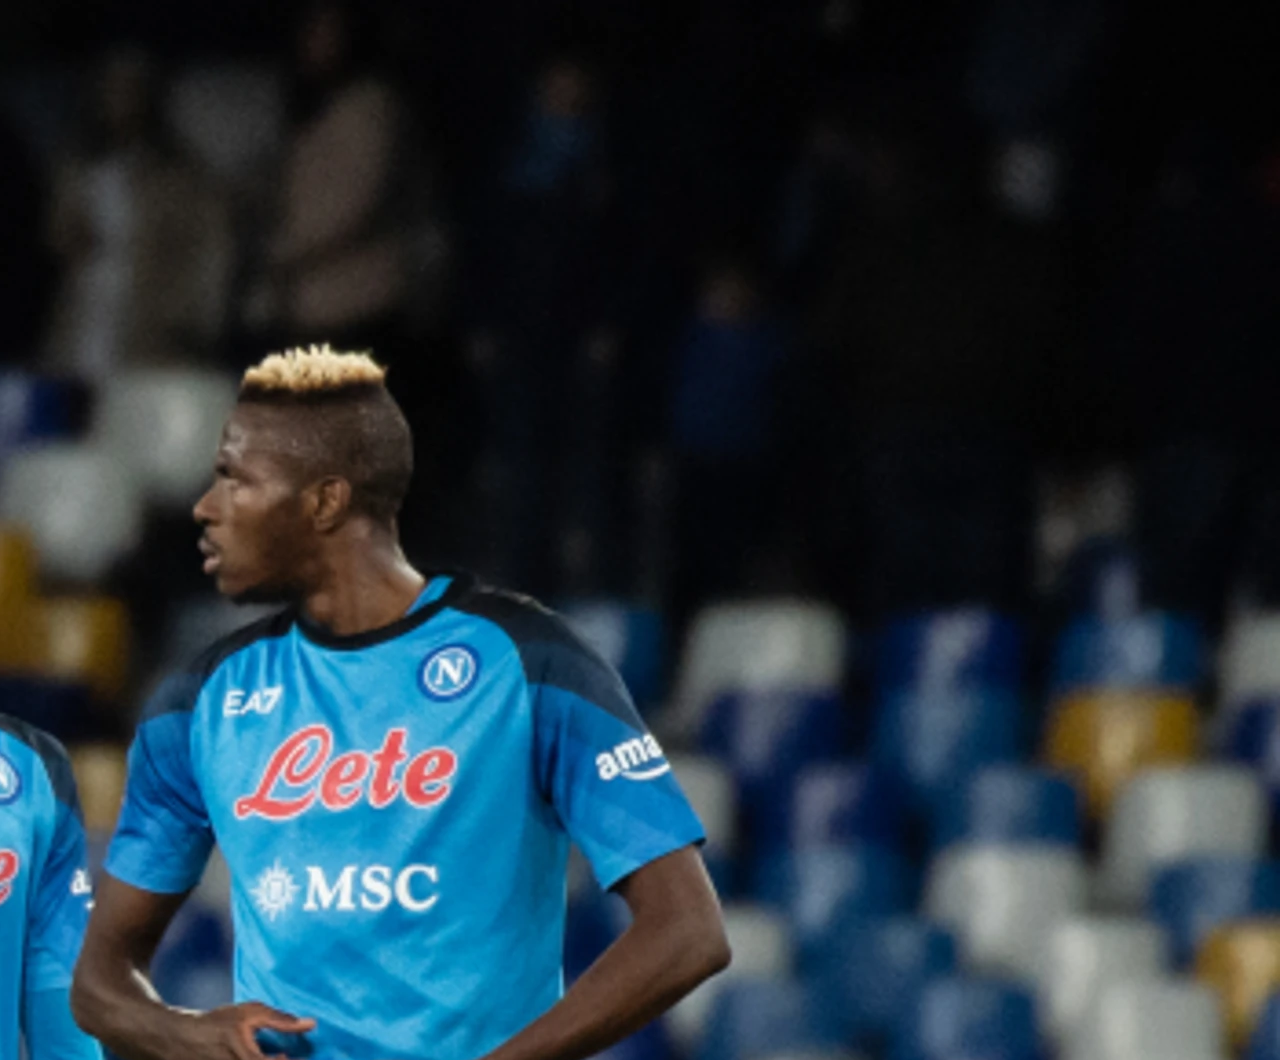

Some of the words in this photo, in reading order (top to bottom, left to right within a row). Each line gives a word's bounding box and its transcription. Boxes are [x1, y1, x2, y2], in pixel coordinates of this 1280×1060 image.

[222, 685, 283, 718] EA7
[234, 723, 457, 820] Lete
[303, 863, 439, 911] MSC
